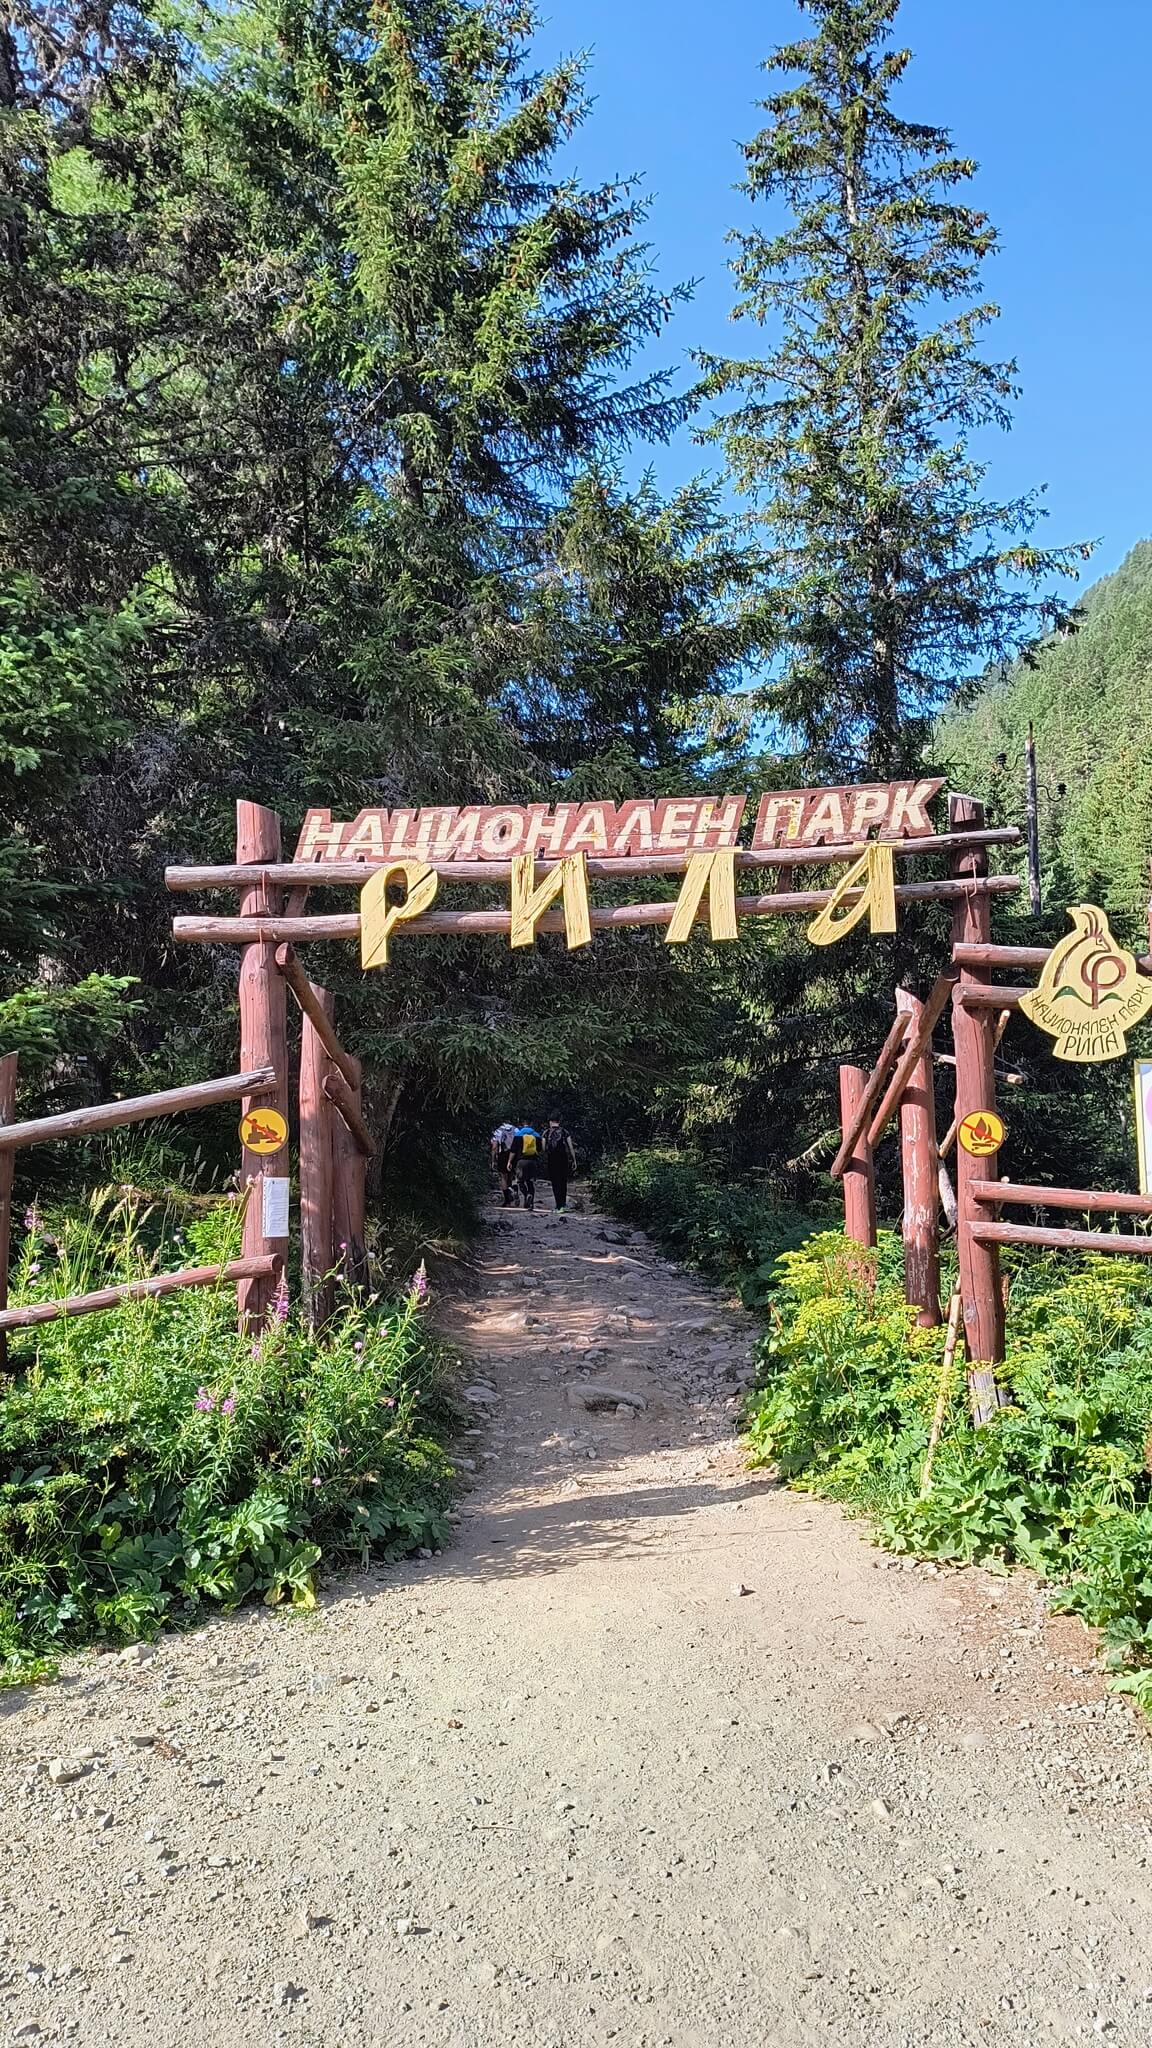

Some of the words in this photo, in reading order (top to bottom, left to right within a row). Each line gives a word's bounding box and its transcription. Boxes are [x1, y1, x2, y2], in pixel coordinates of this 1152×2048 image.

[300, 801, 740, 864] НАЦИОНАЛЕН
[762, 784, 934, 843] ПАРК
[360, 840, 904, 970] РИЛА
[1030, 995, 1120, 1036] НАЦИОНАЛЕН
[1118, 983, 1152, 1021] ПАРК
[1063, 1031, 1119, 1057] РИЛА
